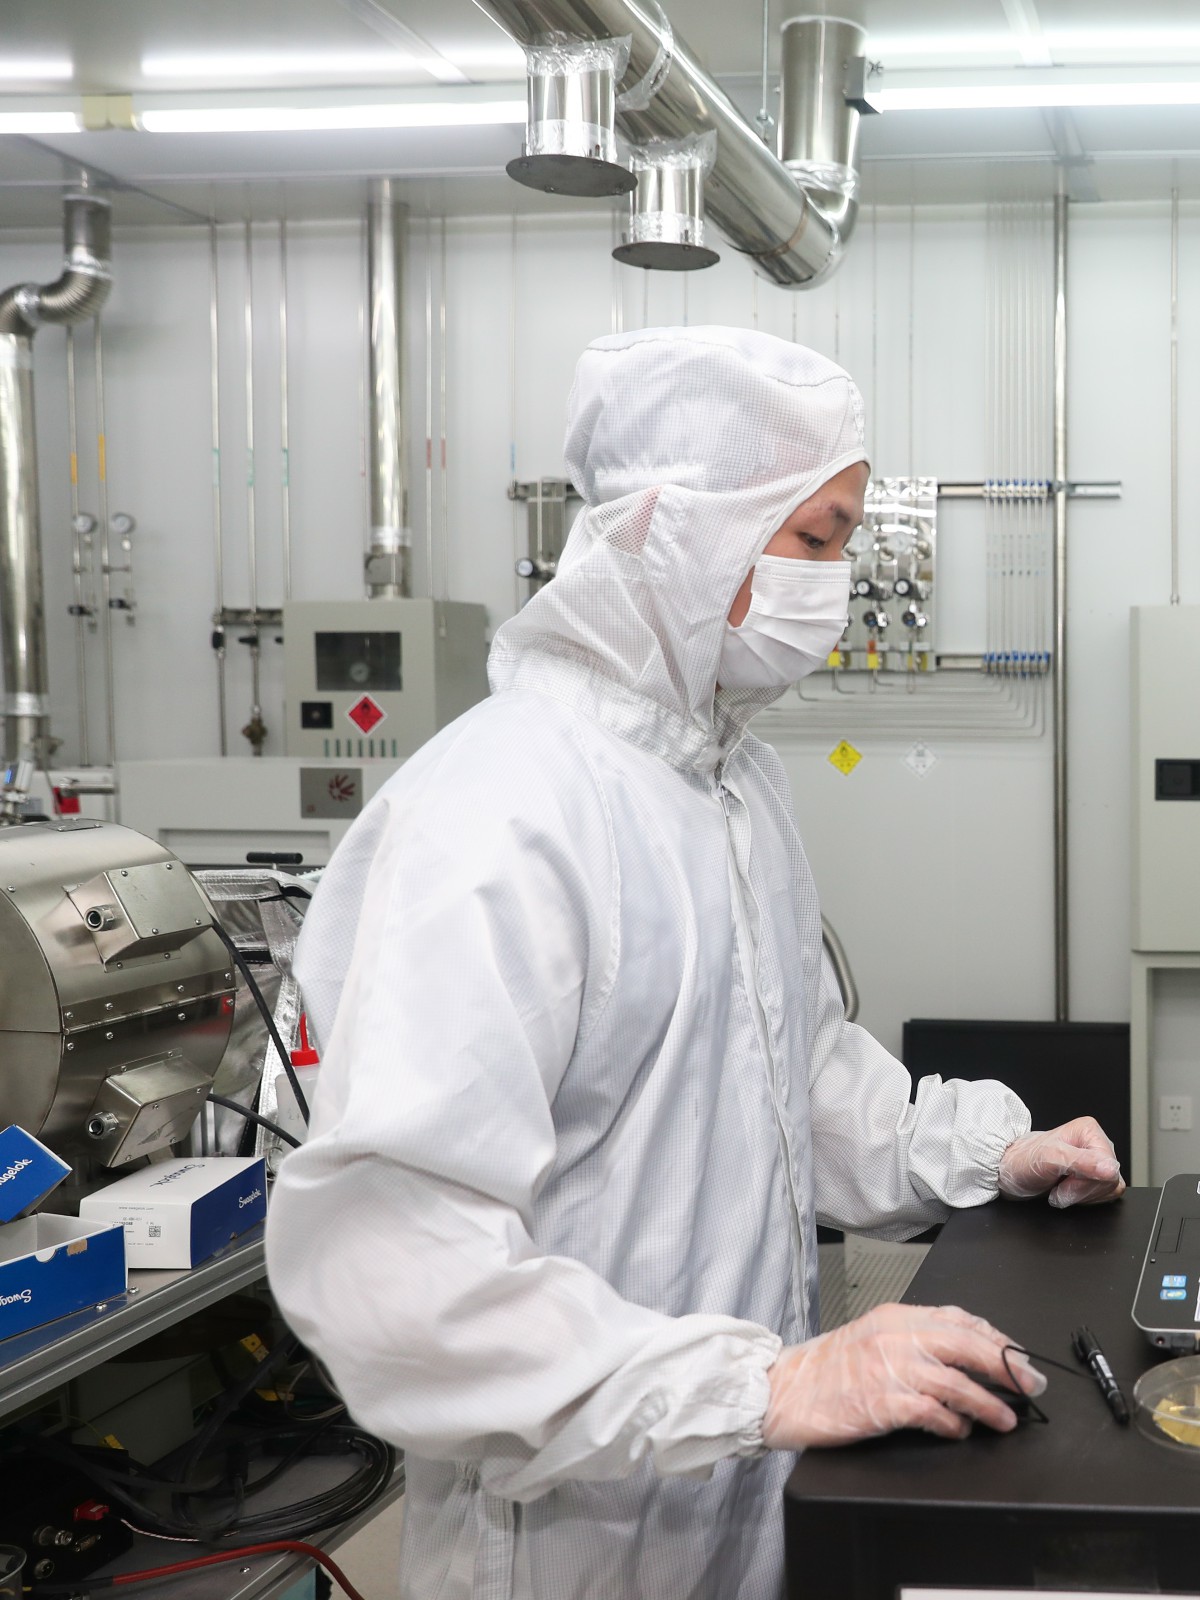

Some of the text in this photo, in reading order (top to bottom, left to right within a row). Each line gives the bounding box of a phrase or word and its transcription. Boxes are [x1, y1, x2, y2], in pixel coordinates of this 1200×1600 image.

[0, 1159, 33, 1186] agelok
[238, 1188, 262, 1209] Swagelok
[0, 1289, 31, 1306] Swag
